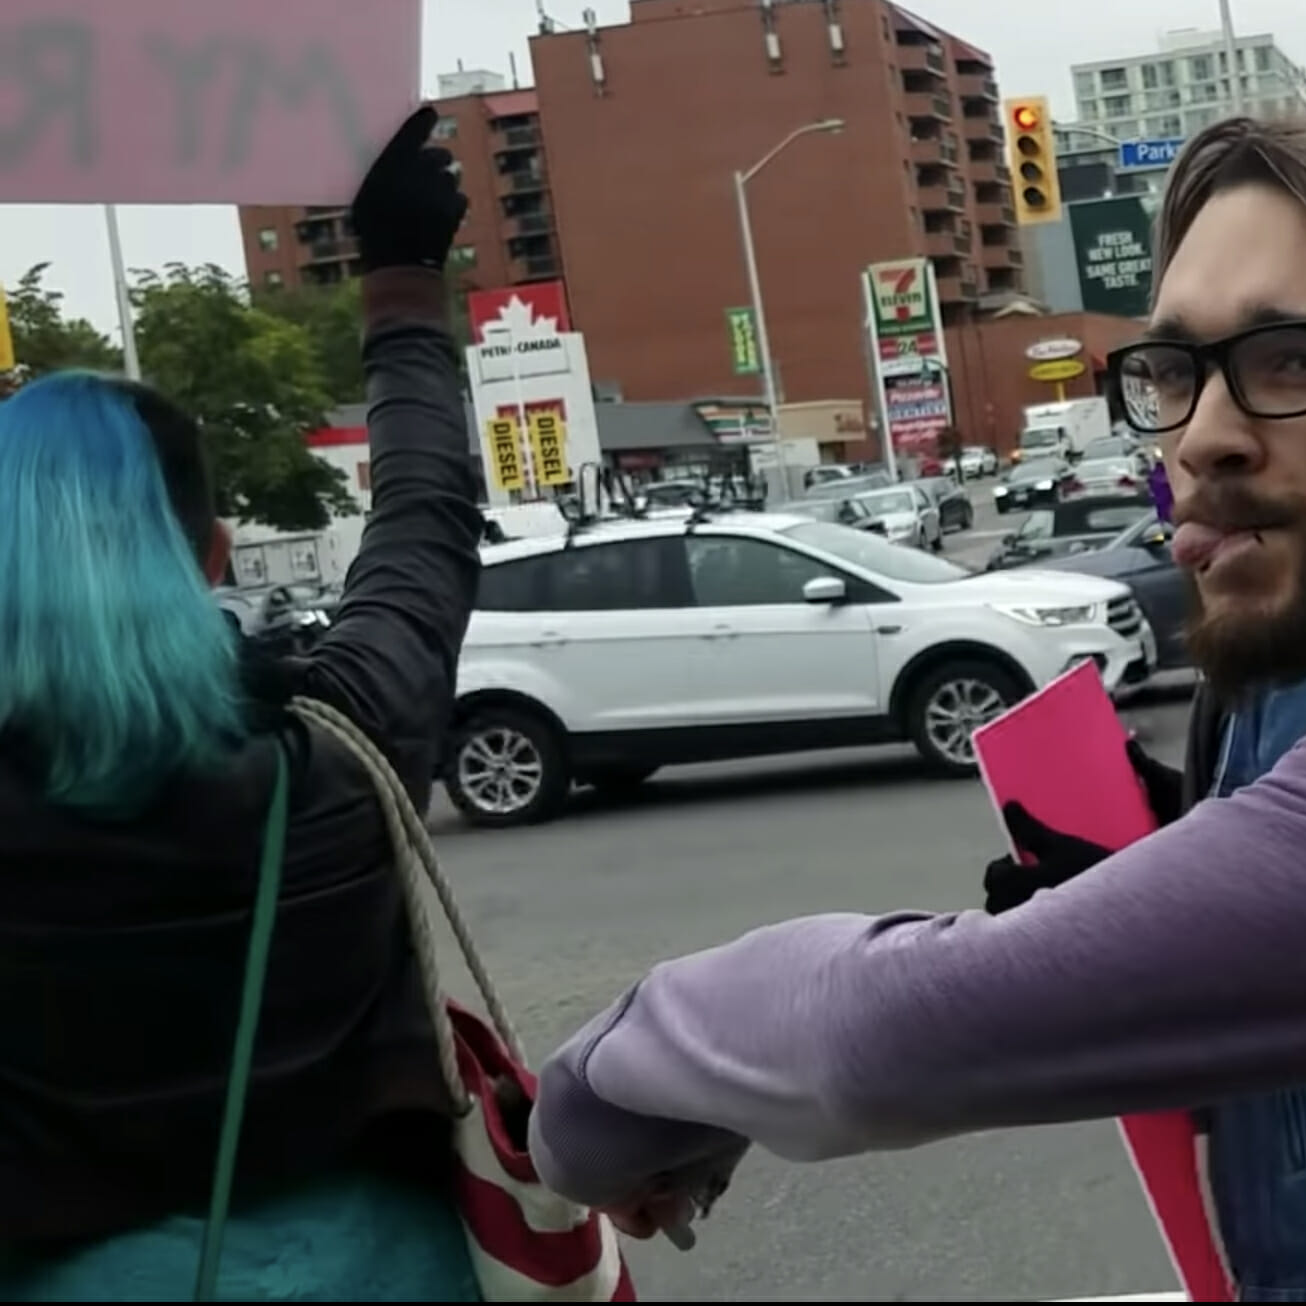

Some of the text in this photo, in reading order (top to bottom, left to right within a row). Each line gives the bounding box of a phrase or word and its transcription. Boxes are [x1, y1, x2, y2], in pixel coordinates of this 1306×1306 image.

[1098, 231, 1133, 247] FRESH
[1088, 247, 1113, 262] NEW
[879, 266, 917, 294] 7
[493, 420, 520, 486] DIESEL
[536, 416, 562, 481] DIESEL
